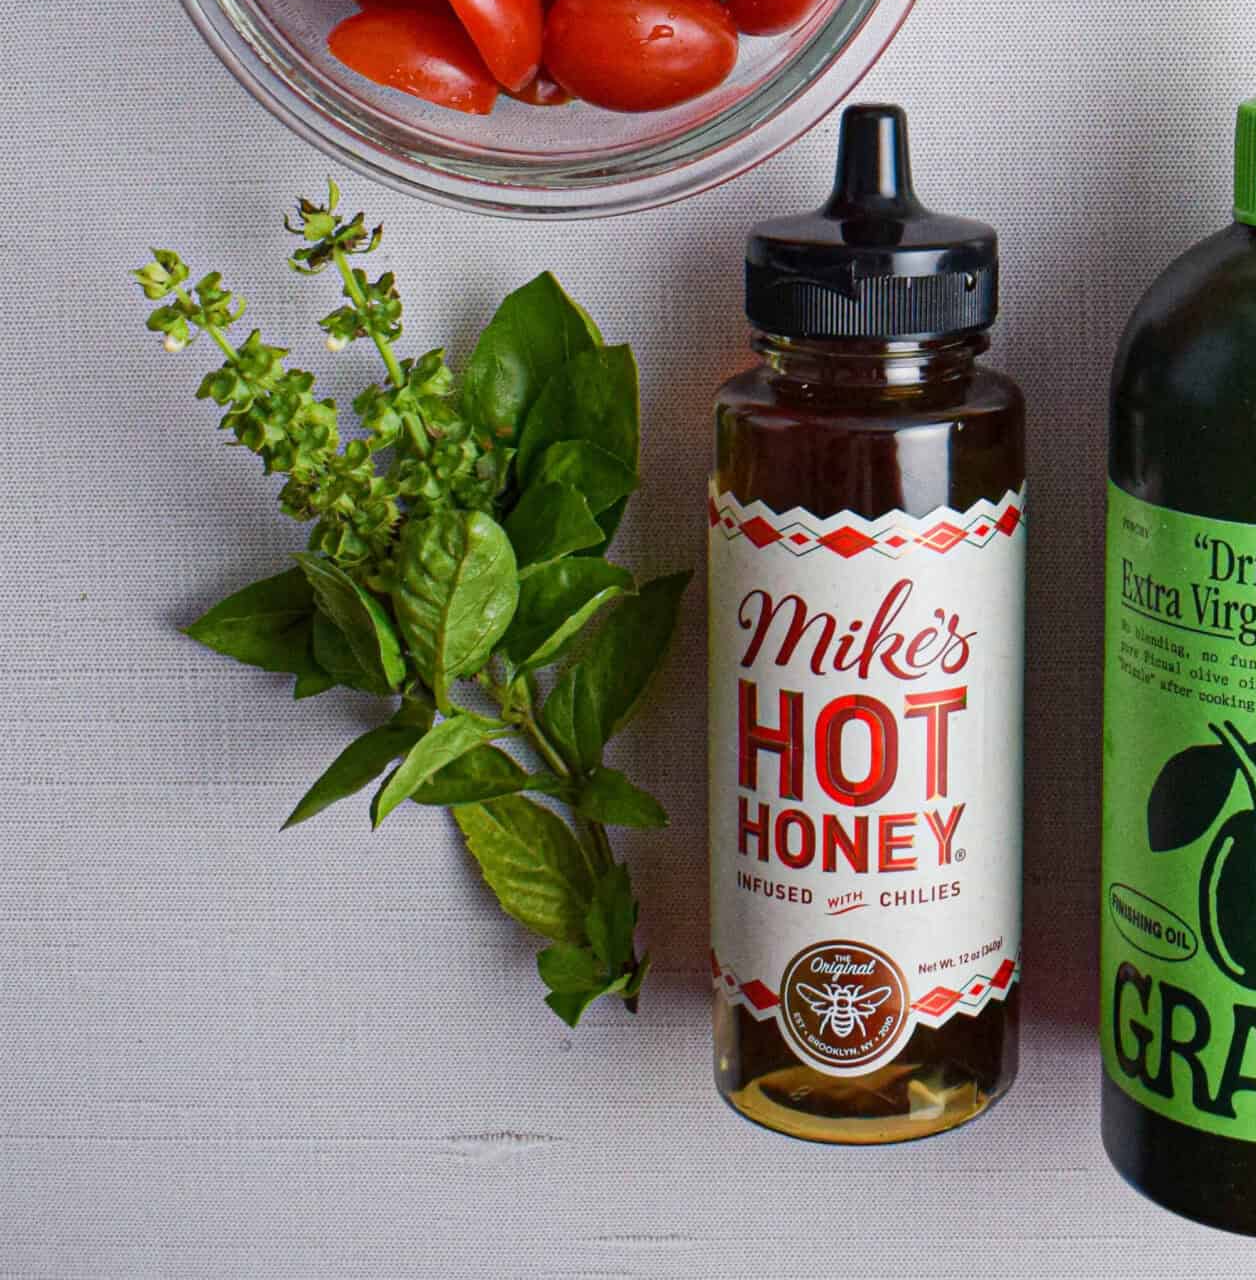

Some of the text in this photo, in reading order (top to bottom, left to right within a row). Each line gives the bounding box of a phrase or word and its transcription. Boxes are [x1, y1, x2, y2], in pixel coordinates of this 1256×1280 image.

[1121, 558, 1182, 619] Extra
[1201, 651, 1219, 663] no
[1190, 667, 1229, 687] olive
[1160, 678, 1193, 698] after
[1199, 690, 1256, 713] cooking
[738, 678, 968, 808] HOT
[737, 871, 813, 905] INFUSED
[827, 891, 863, 909] WITH
[879, 880, 961, 908] CHILIES
[1111, 893, 1191, 952] FINISHING OIL
[810, 956, 877, 982] Original
[835, 954, 851, 962] THE
[918, 962, 937, 975] Net
[940, 958, 956, 969] Wt.
[959, 953, 970, 965] 12
[970, 951, 980, 961] oz
[878, 1015, 893, 1037] 2010
